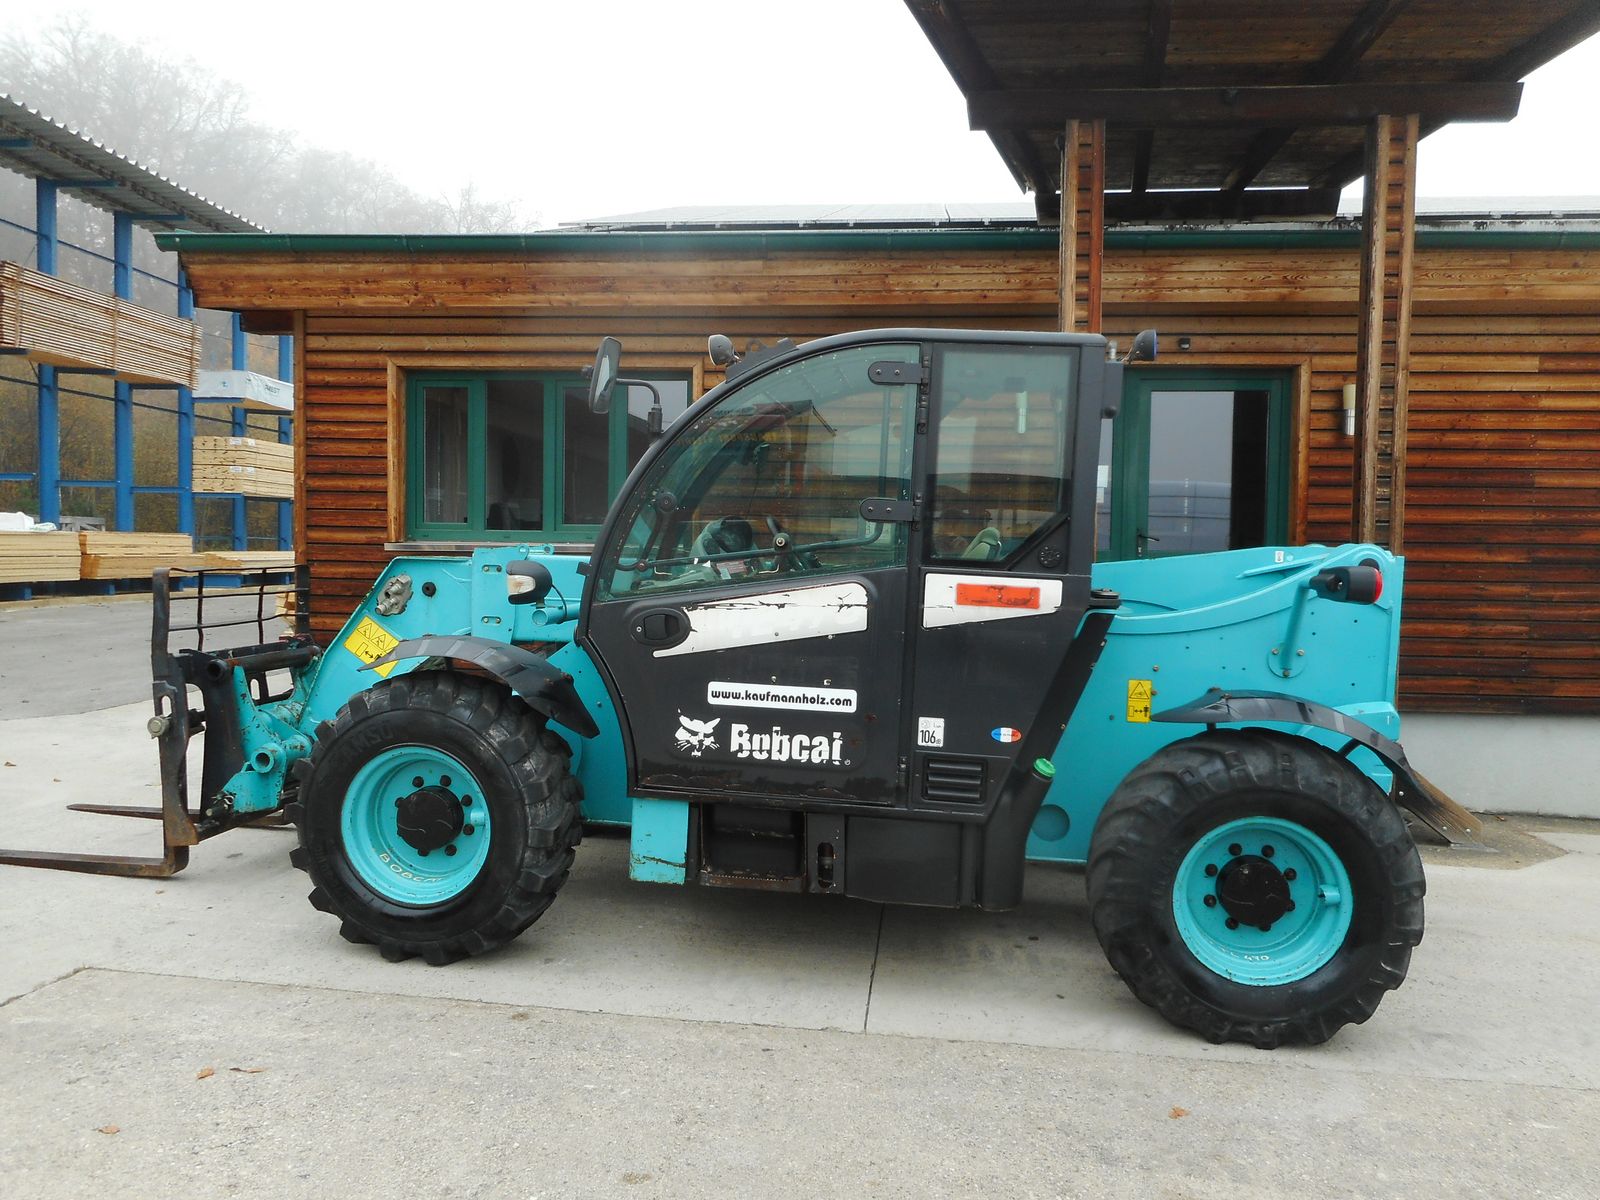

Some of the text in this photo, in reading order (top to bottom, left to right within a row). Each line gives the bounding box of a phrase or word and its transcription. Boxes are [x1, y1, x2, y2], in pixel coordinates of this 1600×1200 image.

[711, 690, 852, 707] www.kaufmannholz.com
[920, 730, 936, 744] 106
[380, 853, 442, 882] BOBCAT
